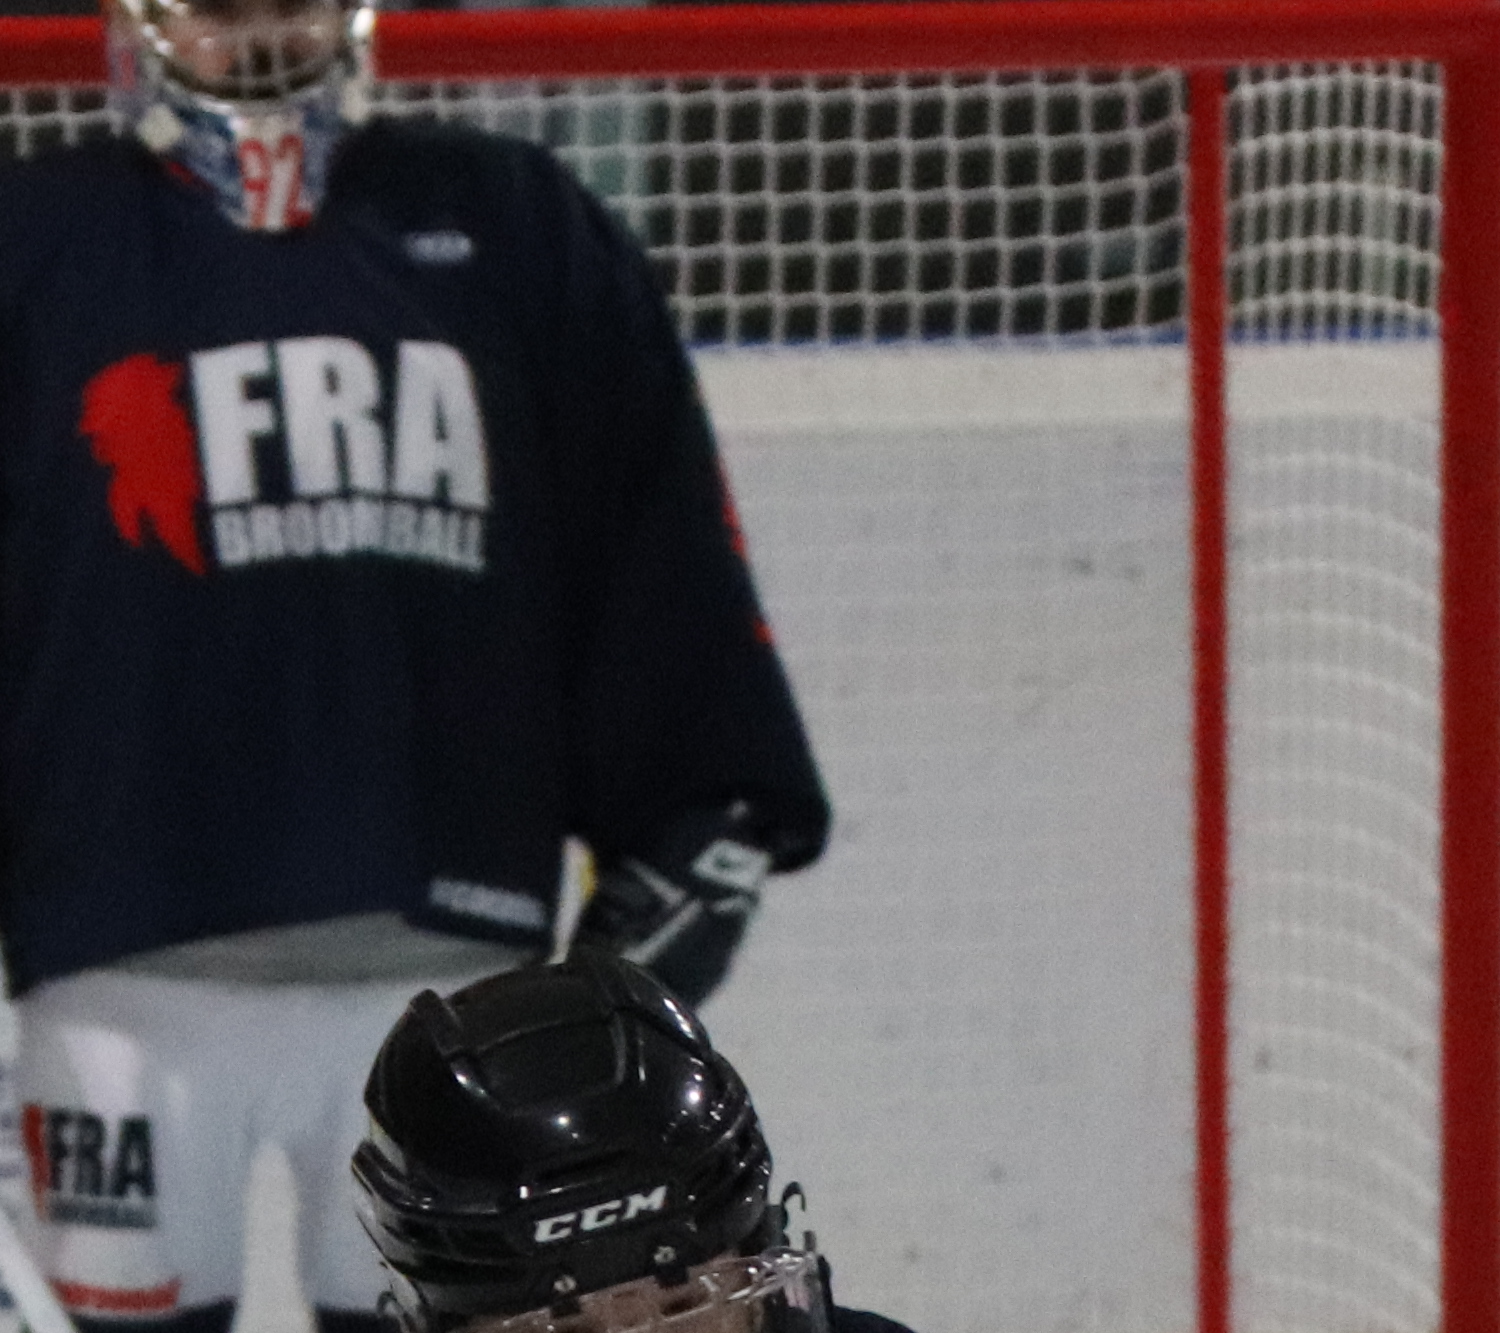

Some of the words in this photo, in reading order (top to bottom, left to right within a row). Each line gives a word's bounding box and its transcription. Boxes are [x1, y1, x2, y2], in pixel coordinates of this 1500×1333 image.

[190, 334, 492, 512] FRA
[47, 1106, 160, 1200] FRA
[534, 1185, 668, 1244] CCM
